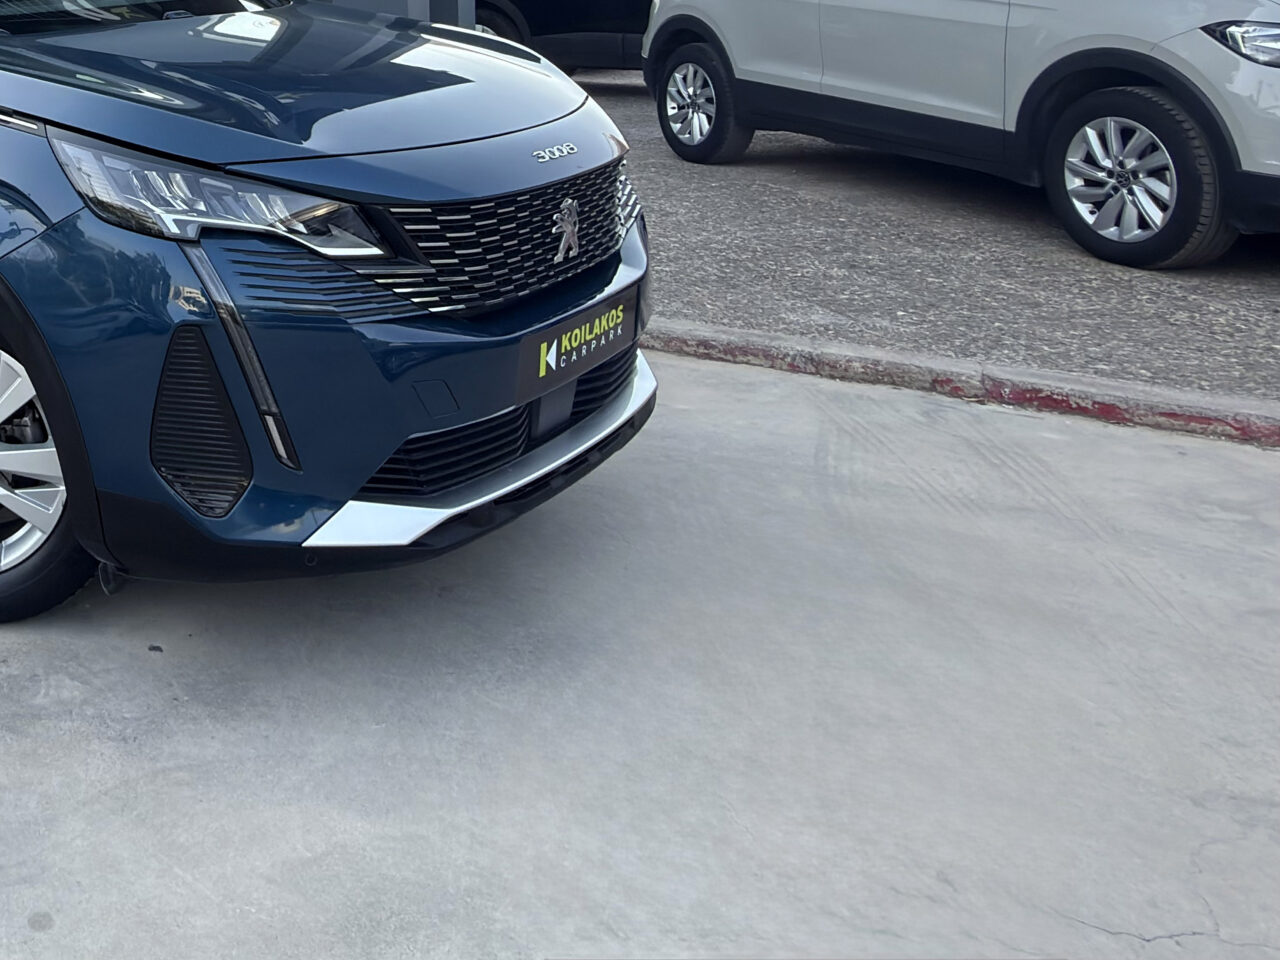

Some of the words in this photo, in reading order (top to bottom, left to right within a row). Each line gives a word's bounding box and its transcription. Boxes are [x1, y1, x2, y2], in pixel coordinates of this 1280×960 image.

[532, 142, 578, 163] 3008
[560, 304, 624, 354] KOILAKOS
[560, 324, 623, 368] CARPARK
